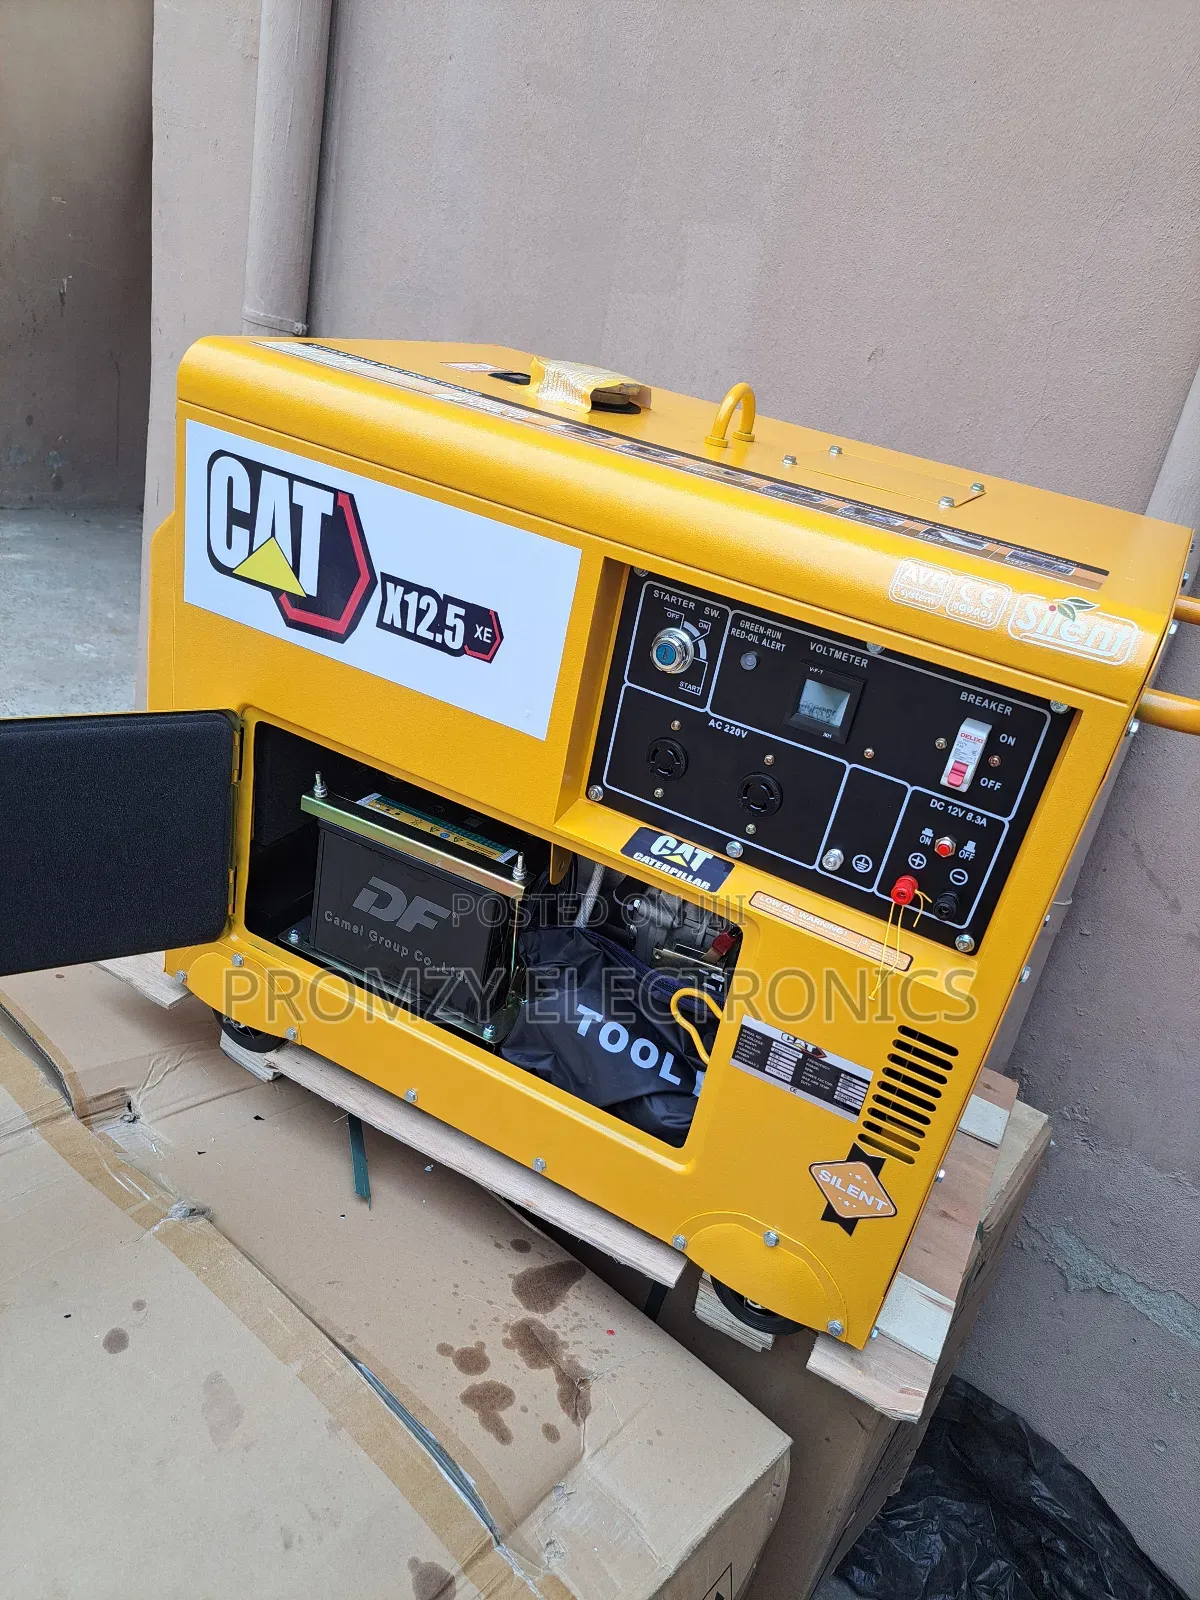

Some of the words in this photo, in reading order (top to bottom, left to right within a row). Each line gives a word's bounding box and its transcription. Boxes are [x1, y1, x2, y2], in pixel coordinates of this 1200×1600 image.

[209, 455, 336, 598] CAT
[900, 562, 947, 592] AVR
[653, 589, 696, 610] STARTER
[703, 607, 721, 619] SW.
[900, 588, 935, 604] system
[383, 580, 466, 650] X12.5
[473, 624, 493, 644] XE
[666, 611, 680, 620] OFF
[698, 622, 709, 631] ON
[1016, 600, 1132, 654] Silent
[730, 628, 759, 644] RED-OIL
[761, 637, 786, 652] ALERT
[740, 619, 782, 640] GREEN-RUN
[809, 641, 869, 668] VOLTMETER
[679, 681, 702, 693] START
[959, 691, 1013, 716] BREAKER
[708, 718, 724, 731] AC
[723, 721, 750, 739] 220V
[999, 733, 1017, 747] ON
[980, 777, 1003, 792] OFF
[929, 798, 946, 812] DC
[947, 804, 966, 818] 12V
[965, 811, 988, 828] 8.3A
[650, 835, 715, 873] CAT
[919, 835, 932, 846] ON
[958, 849, 976, 862] OFF
[632, 852, 713, 891] CATERPILLAR
[352, 876, 452, 932] DF
[759, 894, 781, 908] LOW
[782, 904, 797, 915] OIL
[798, 911, 849, 937] WARNING!
[324, 909, 364, 937] Camel
[368, 930, 409, 957] Group
[576, 1003, 682, 1086] TOOL
[781, 1032, 816, 1053] CAT
[818, 1169, 888, 1211] SILENT
